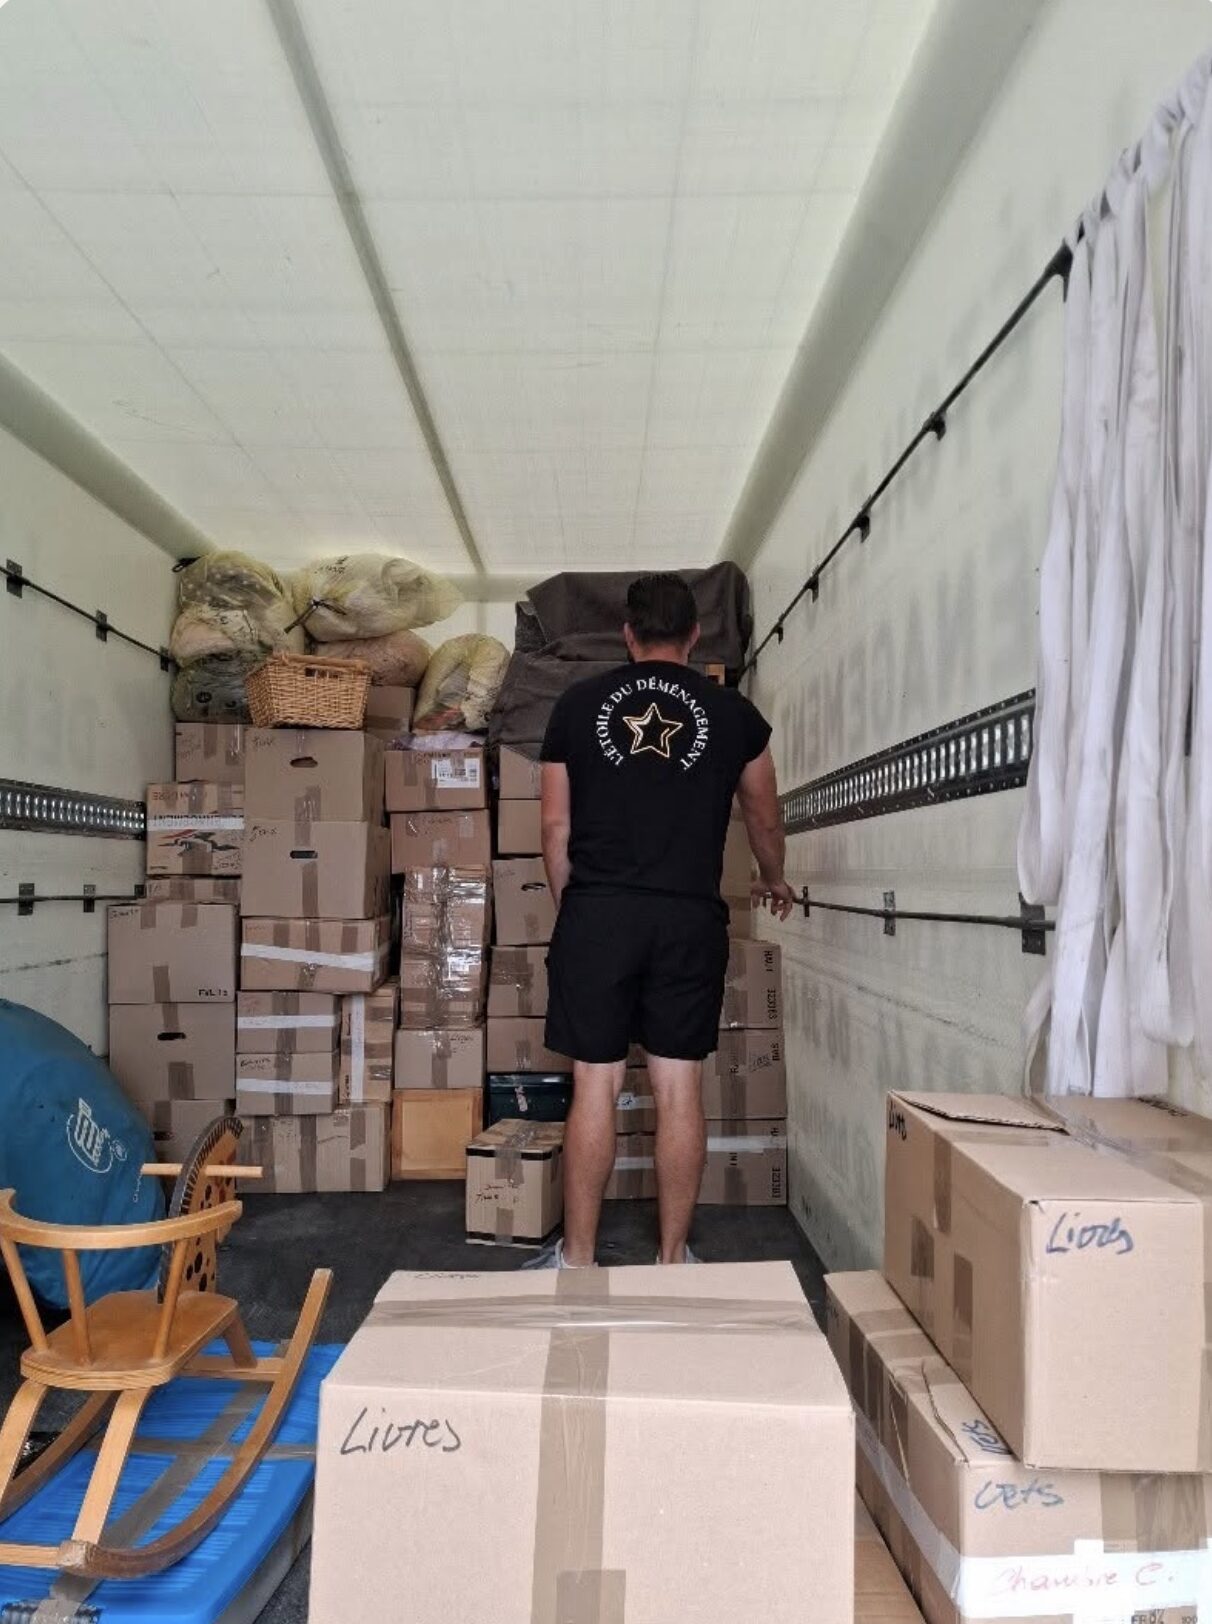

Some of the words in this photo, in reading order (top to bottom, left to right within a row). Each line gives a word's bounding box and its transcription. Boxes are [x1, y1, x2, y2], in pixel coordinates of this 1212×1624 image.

[596, 702, 625, 767] L'ÉTOILE
[611, 683, 633, 704] DU
[636, 676, 710, 771] DÉMÉNAGEMENT
[340, 1406, 462, 1455] Livres
